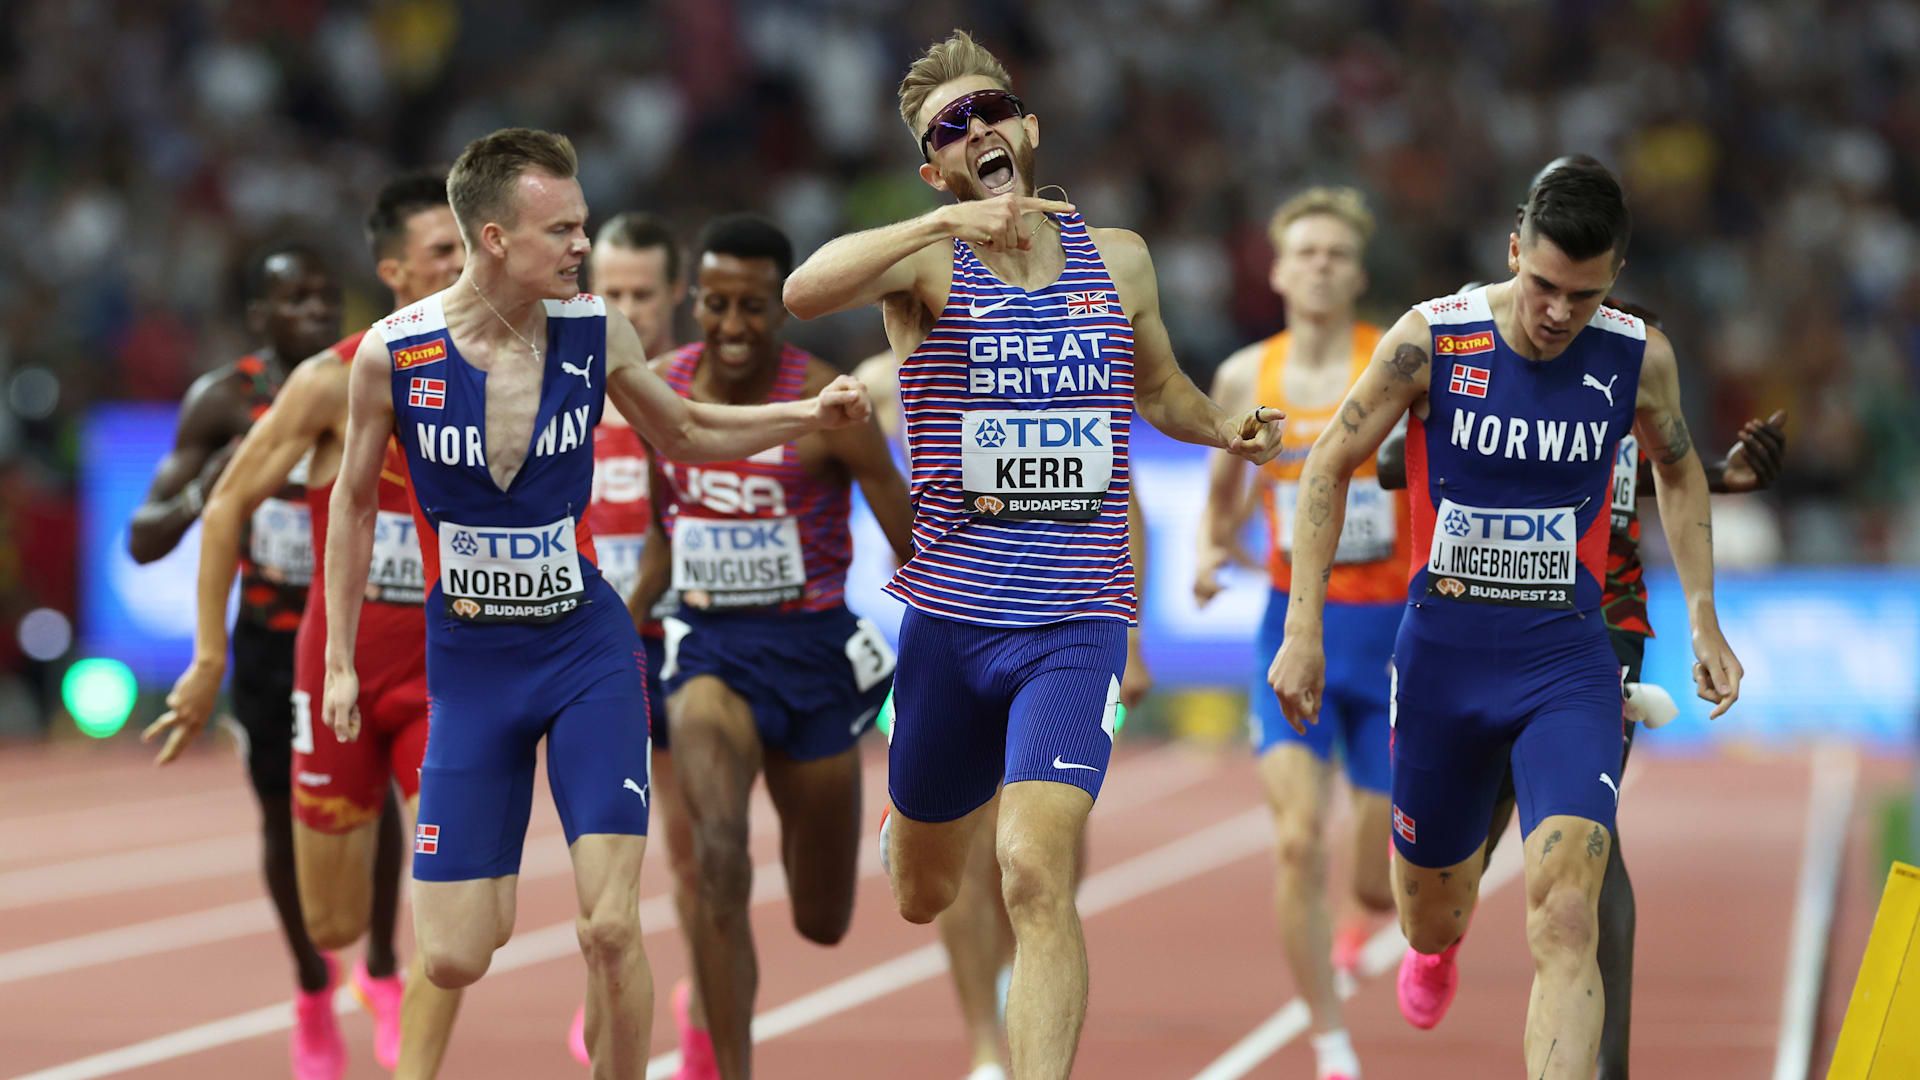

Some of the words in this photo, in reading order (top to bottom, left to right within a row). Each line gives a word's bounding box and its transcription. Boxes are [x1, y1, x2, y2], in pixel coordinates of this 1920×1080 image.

[969, 332, 1107, 363] GREAT
[1455, 337, 1490, 350] EXTRA
[969, 364, 1112, 394] BRITAIN
[1006, 417, 1104, 448] TDK
[1450, 408, 1609, 462] NORWAY
[996, 457, 1083, 489] KERR
[1009, 499, 1089, 512] BUDAPEST
[477, 525, 569, 560] TDK
[705, 524, 786, 551] TDK
[1471, 512, 1566, 542] TDK
[684, 554, 796, 585] NUGUSE
[1433, 541, 1445, 572] J.
[1450, 542, 1570, 580] INGEBRIGTSEN
[449, 564, 572, 597] NORDÅS
[1470, 585, 1548, 601] BUDAPEST
[1549, 589, 1567, 602] 23
[485, 602, 559, 617] BUDAPEST
